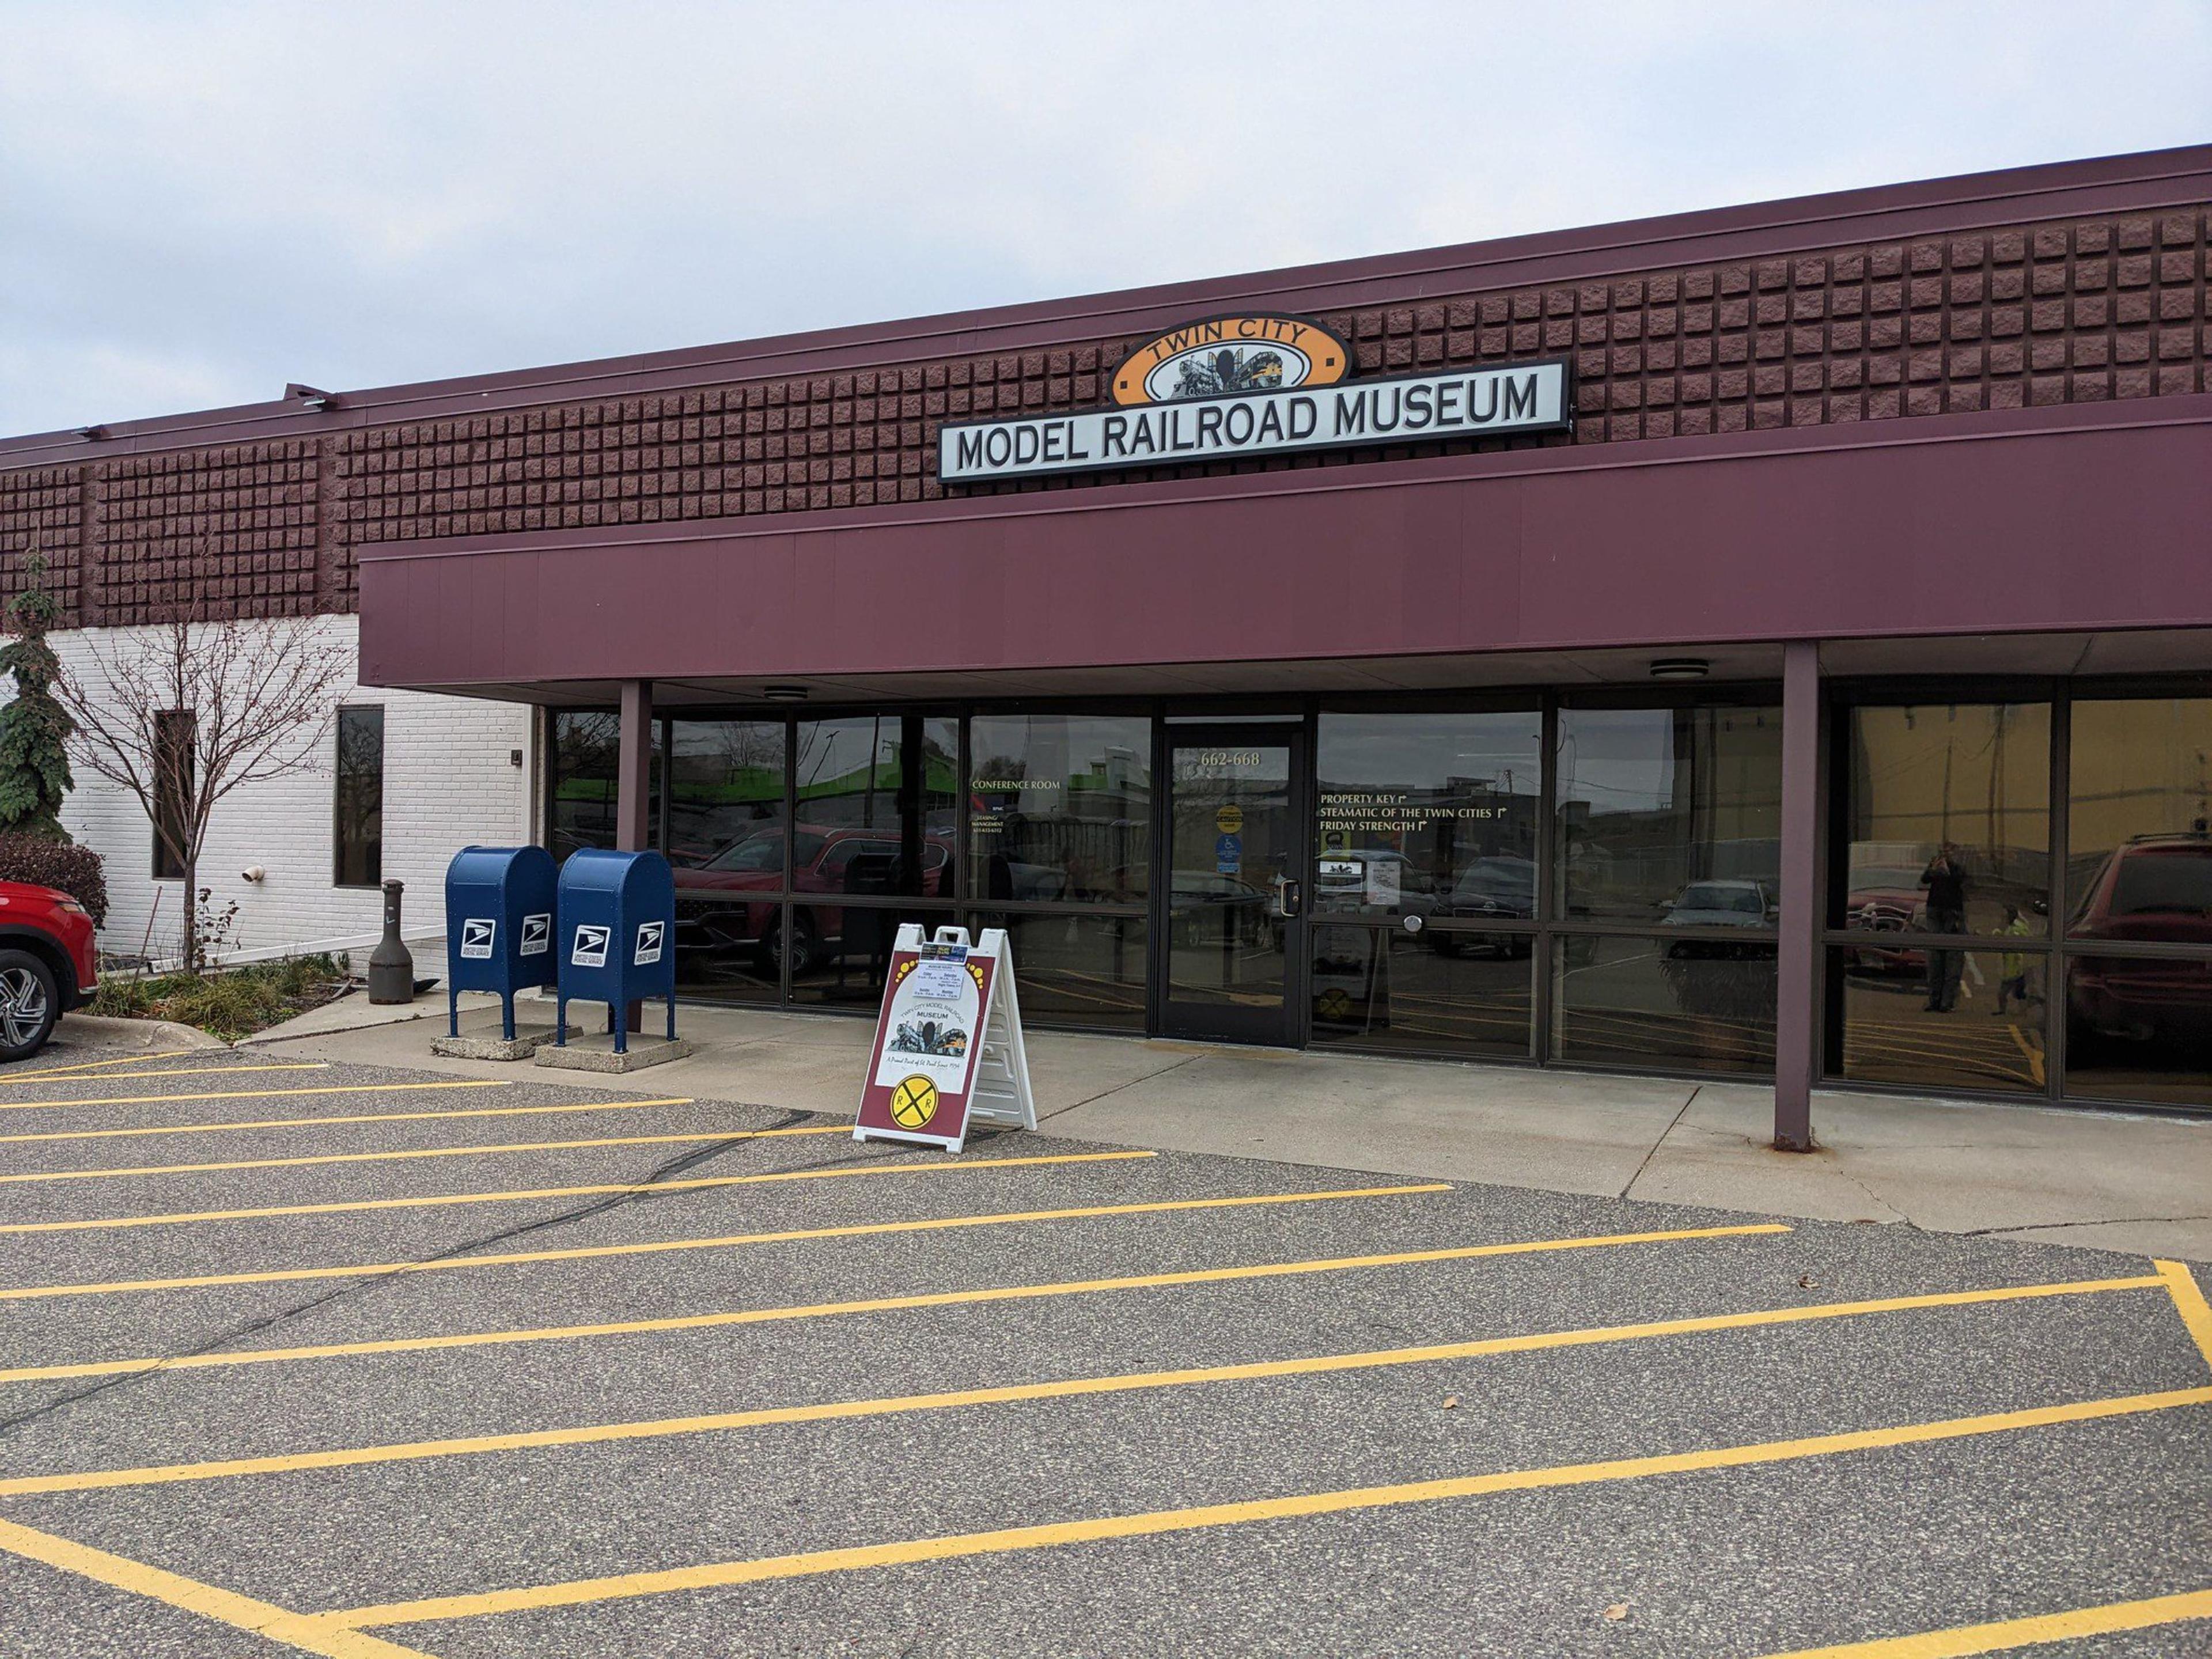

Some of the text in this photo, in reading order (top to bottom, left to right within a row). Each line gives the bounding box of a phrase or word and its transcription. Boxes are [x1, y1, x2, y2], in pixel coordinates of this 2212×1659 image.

[1146, 319, 1308, 361] TWIN CITY
[957, 373, 1539, 471] MODEL RAILROAD MUSEUM
[1201, 752, 1260, 766] 662-668
[972, 780, 1060, 790] CONFERENCE ROOM
[1320, 794, 1396, 804] PROPERTY KEY
[1320, 808, 1492, 819] STEAMATIC OF THE TWIN CITIES
[1320, 821, 1415, 831] FRIDAY STRENGTH
[901, 1007, 914, 1018] TWIN
[944, 1005, 964, 1024] RAILROAD
[916, 1011, 949, 1019] MUSEUM
[896, 1095, 932, 1108] R R
